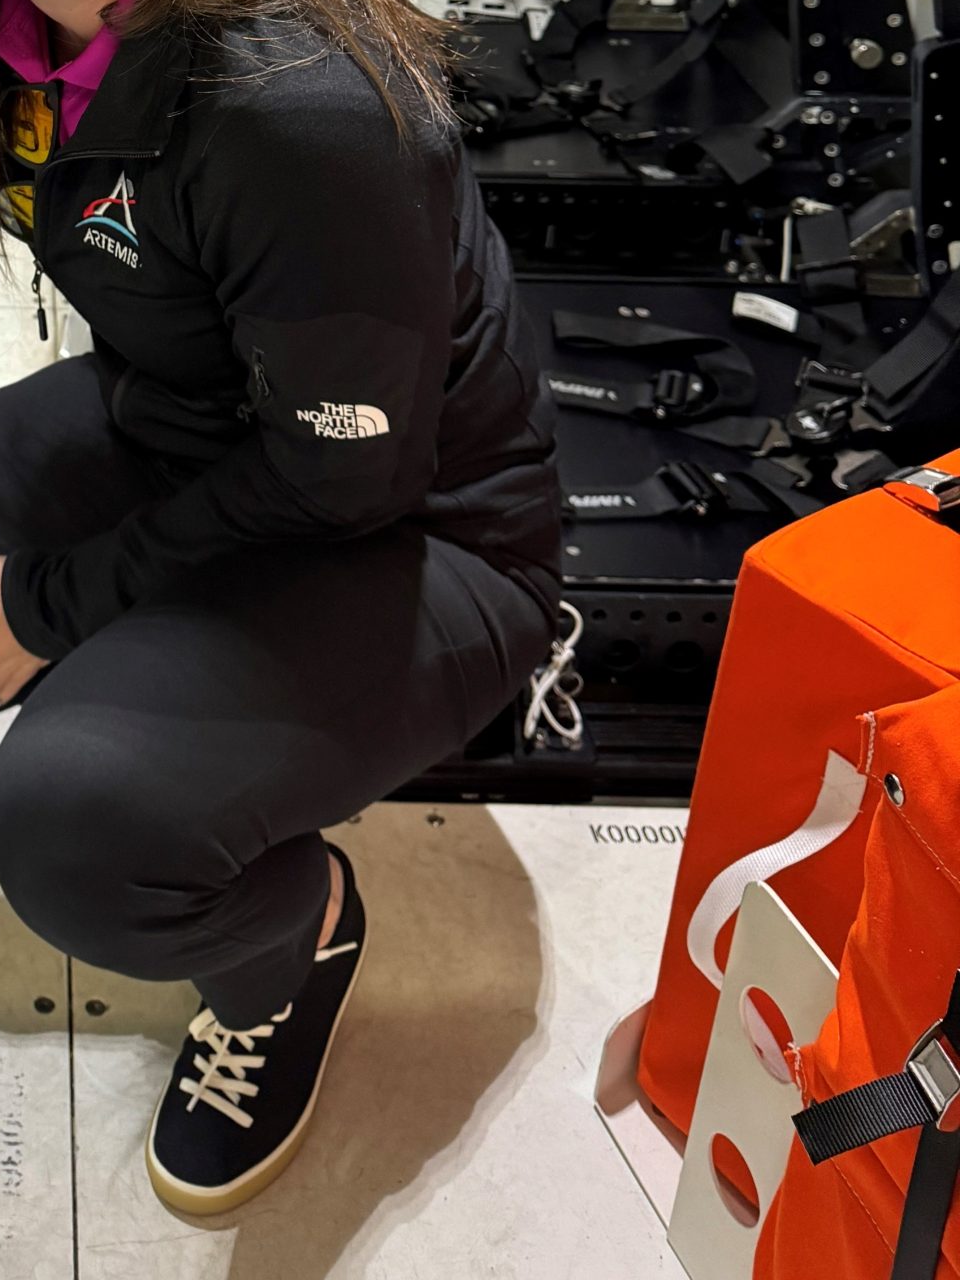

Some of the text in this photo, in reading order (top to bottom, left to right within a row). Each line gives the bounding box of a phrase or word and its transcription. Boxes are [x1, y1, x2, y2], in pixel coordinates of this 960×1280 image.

[83, 227, 139, 269] ARTEMIS
[320, 402, 355, 416] THE
[296, 410, 357, 428] NORTH
[315, 423, 359, 440] FACE
